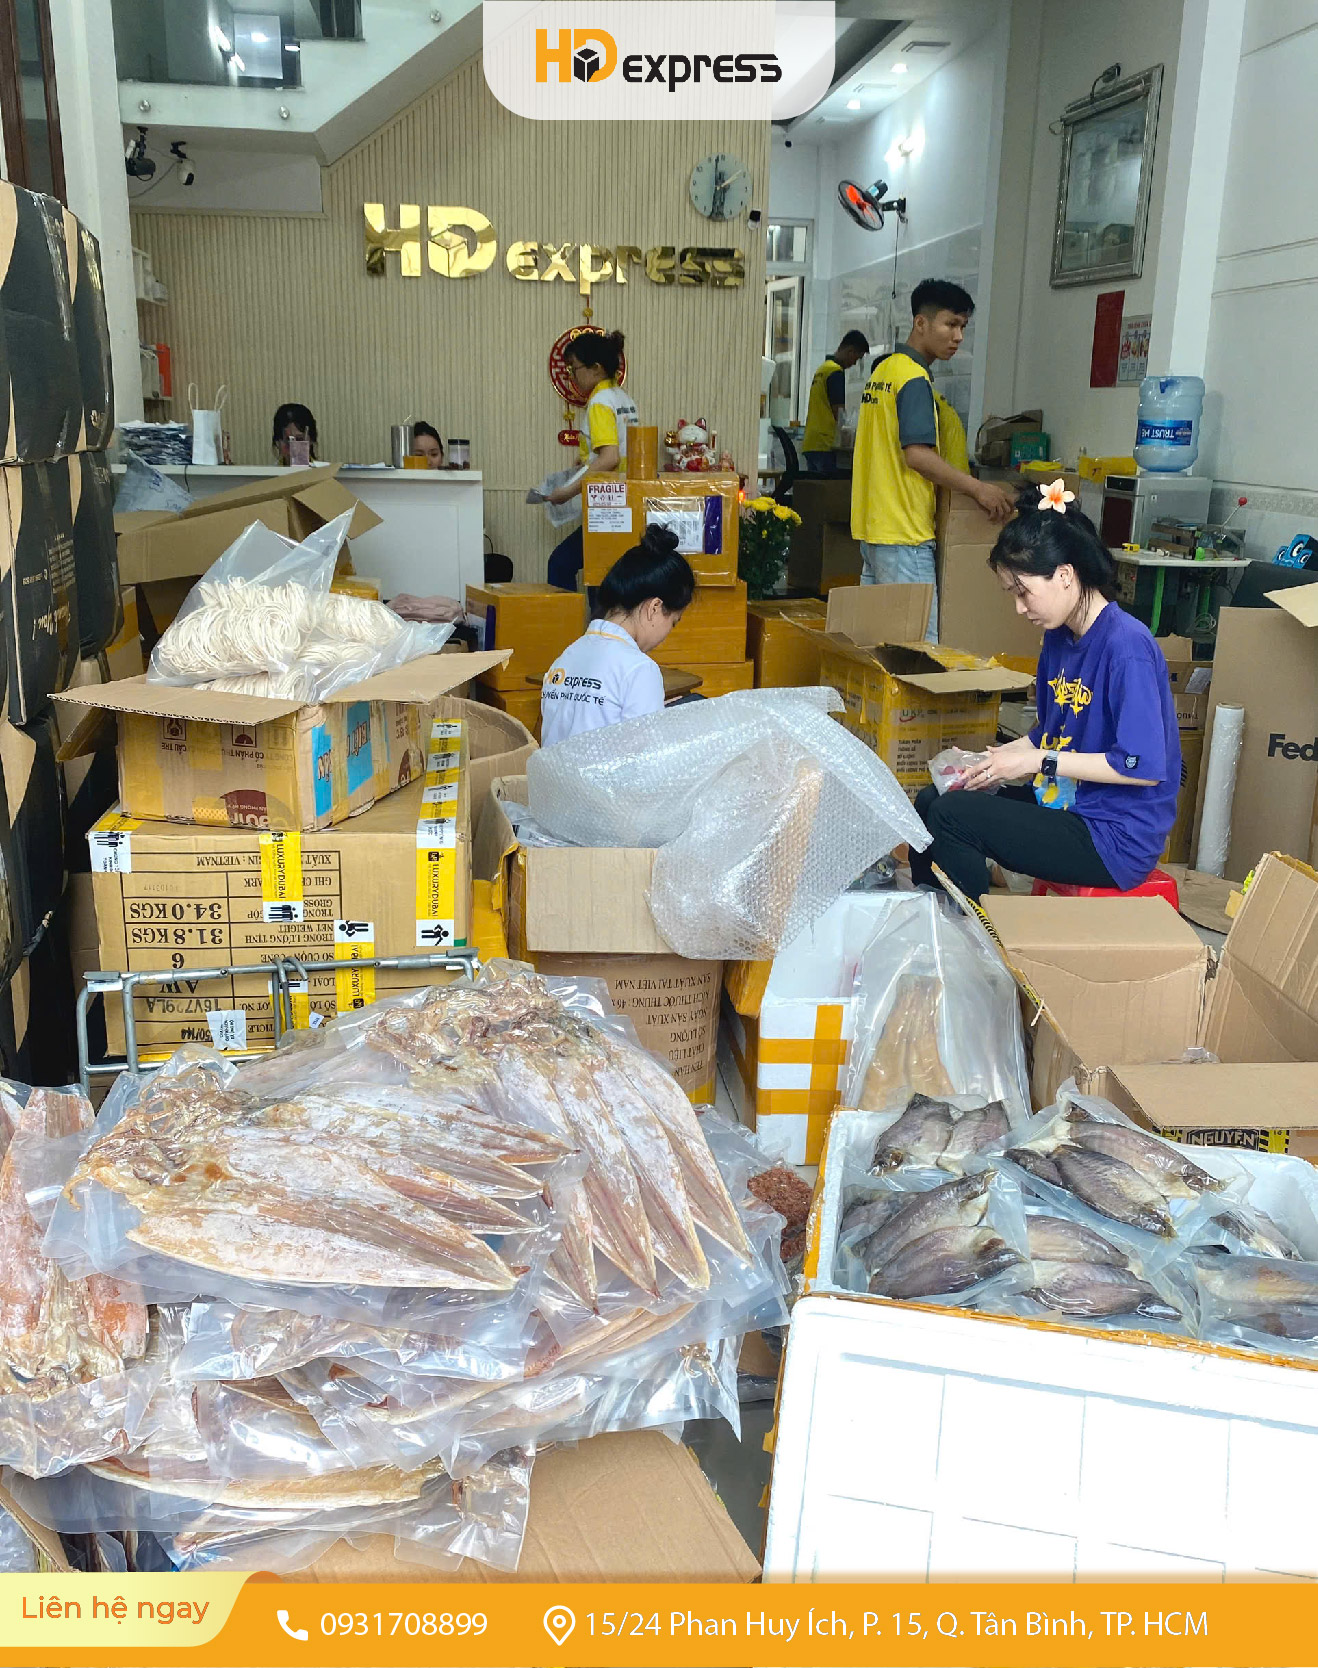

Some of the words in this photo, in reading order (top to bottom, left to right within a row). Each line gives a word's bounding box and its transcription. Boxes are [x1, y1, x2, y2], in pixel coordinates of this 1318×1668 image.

[364, 203, 498, 279] HD
[1151, 429, 1174, 438] TRUST
[589, 484, 625, 493] FRAGILE
[161, 742, 173, 750] TRE
[1268, 733, 1318, 761] Fed
[196, 856, 240, 866] VIETNAM
[306, 854, 332, 868] XUẤT
[276, 844, 286, 899] LUXURYDUBAI
[244, 878, 262, 887] ARK
[315, 877, 332, 886] GHI
[431, 864, 439, 917] LUXURYDUBAI
[303, 899, 333, 908] GROSS
[130, 903, 168, 919] KGS
[171, 903, 222, 920] 34.0
[278, 924, 314, 933] WEIGHT
[316, 924, 334, 932] NET
[132, 928, 170, 944] KGS
[173, 929, 223, 945] 31.8
[171, 953, 184, 969] 6
[313, 976, 335, 987] LOẠI
[615, 979, 635, 990] NAM
[637, 977, 657, 992] VIỆT
[324, 1000, 336, 1012] SỐ
[616, 999, 627, 1008] 46
[247, 1024, 273, 1033] TICLE
